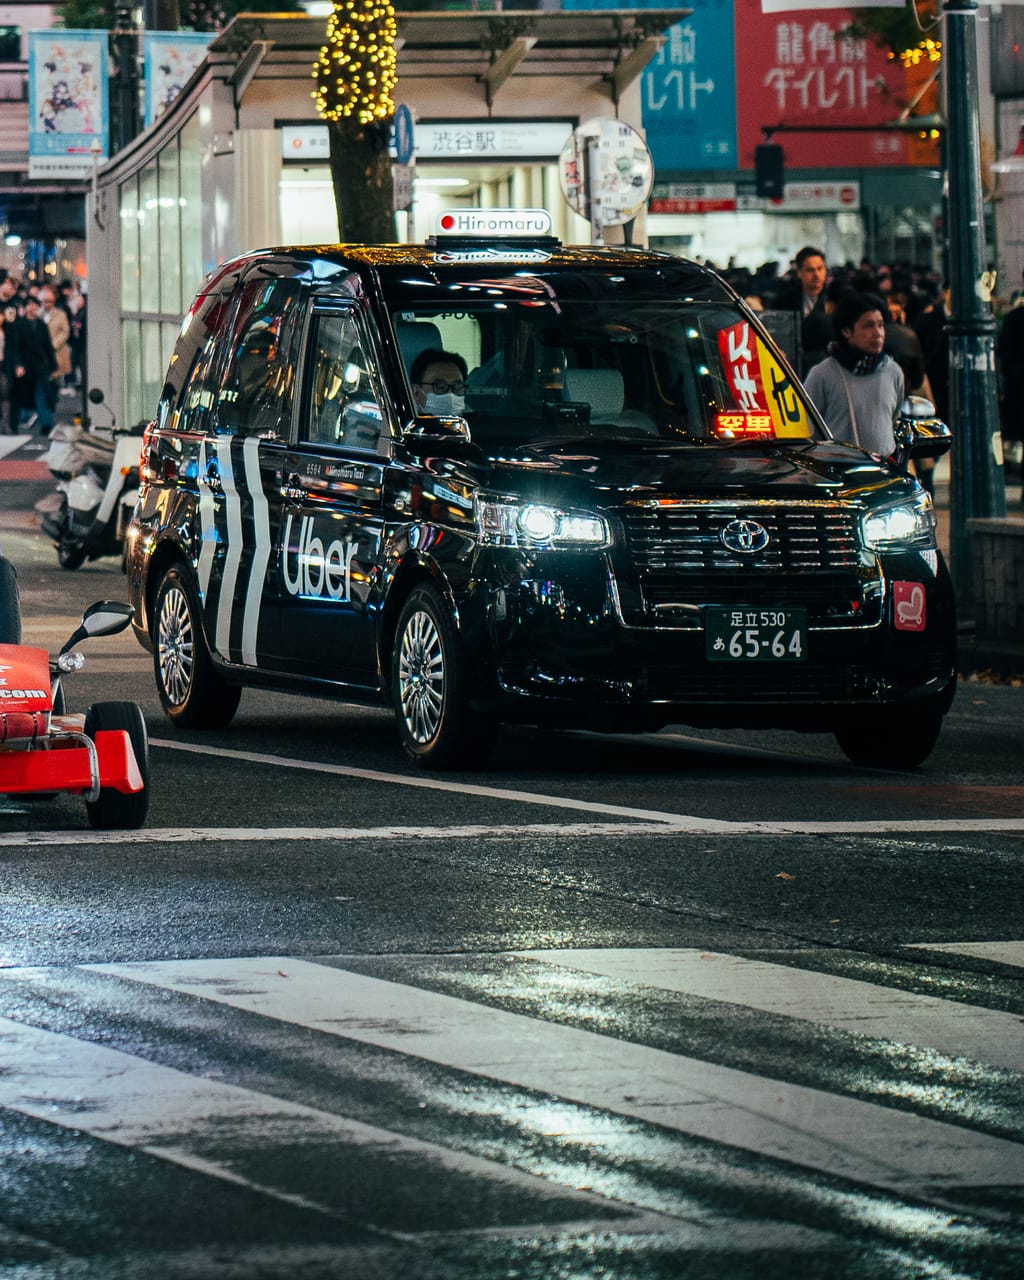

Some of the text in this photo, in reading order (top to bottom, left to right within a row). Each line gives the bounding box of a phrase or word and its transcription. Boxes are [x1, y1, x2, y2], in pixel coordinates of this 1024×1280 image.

[764, 67, 885, 110] ダイレクト
[432, 130, 496, 152] 渋谷駅
[458, 213, 544, 231] Hinomaru
[283, 515, 359, 602] Uber
[730, 612, 786, 627] 足立 530
[713, 630, 802, 657] あ 65-64
